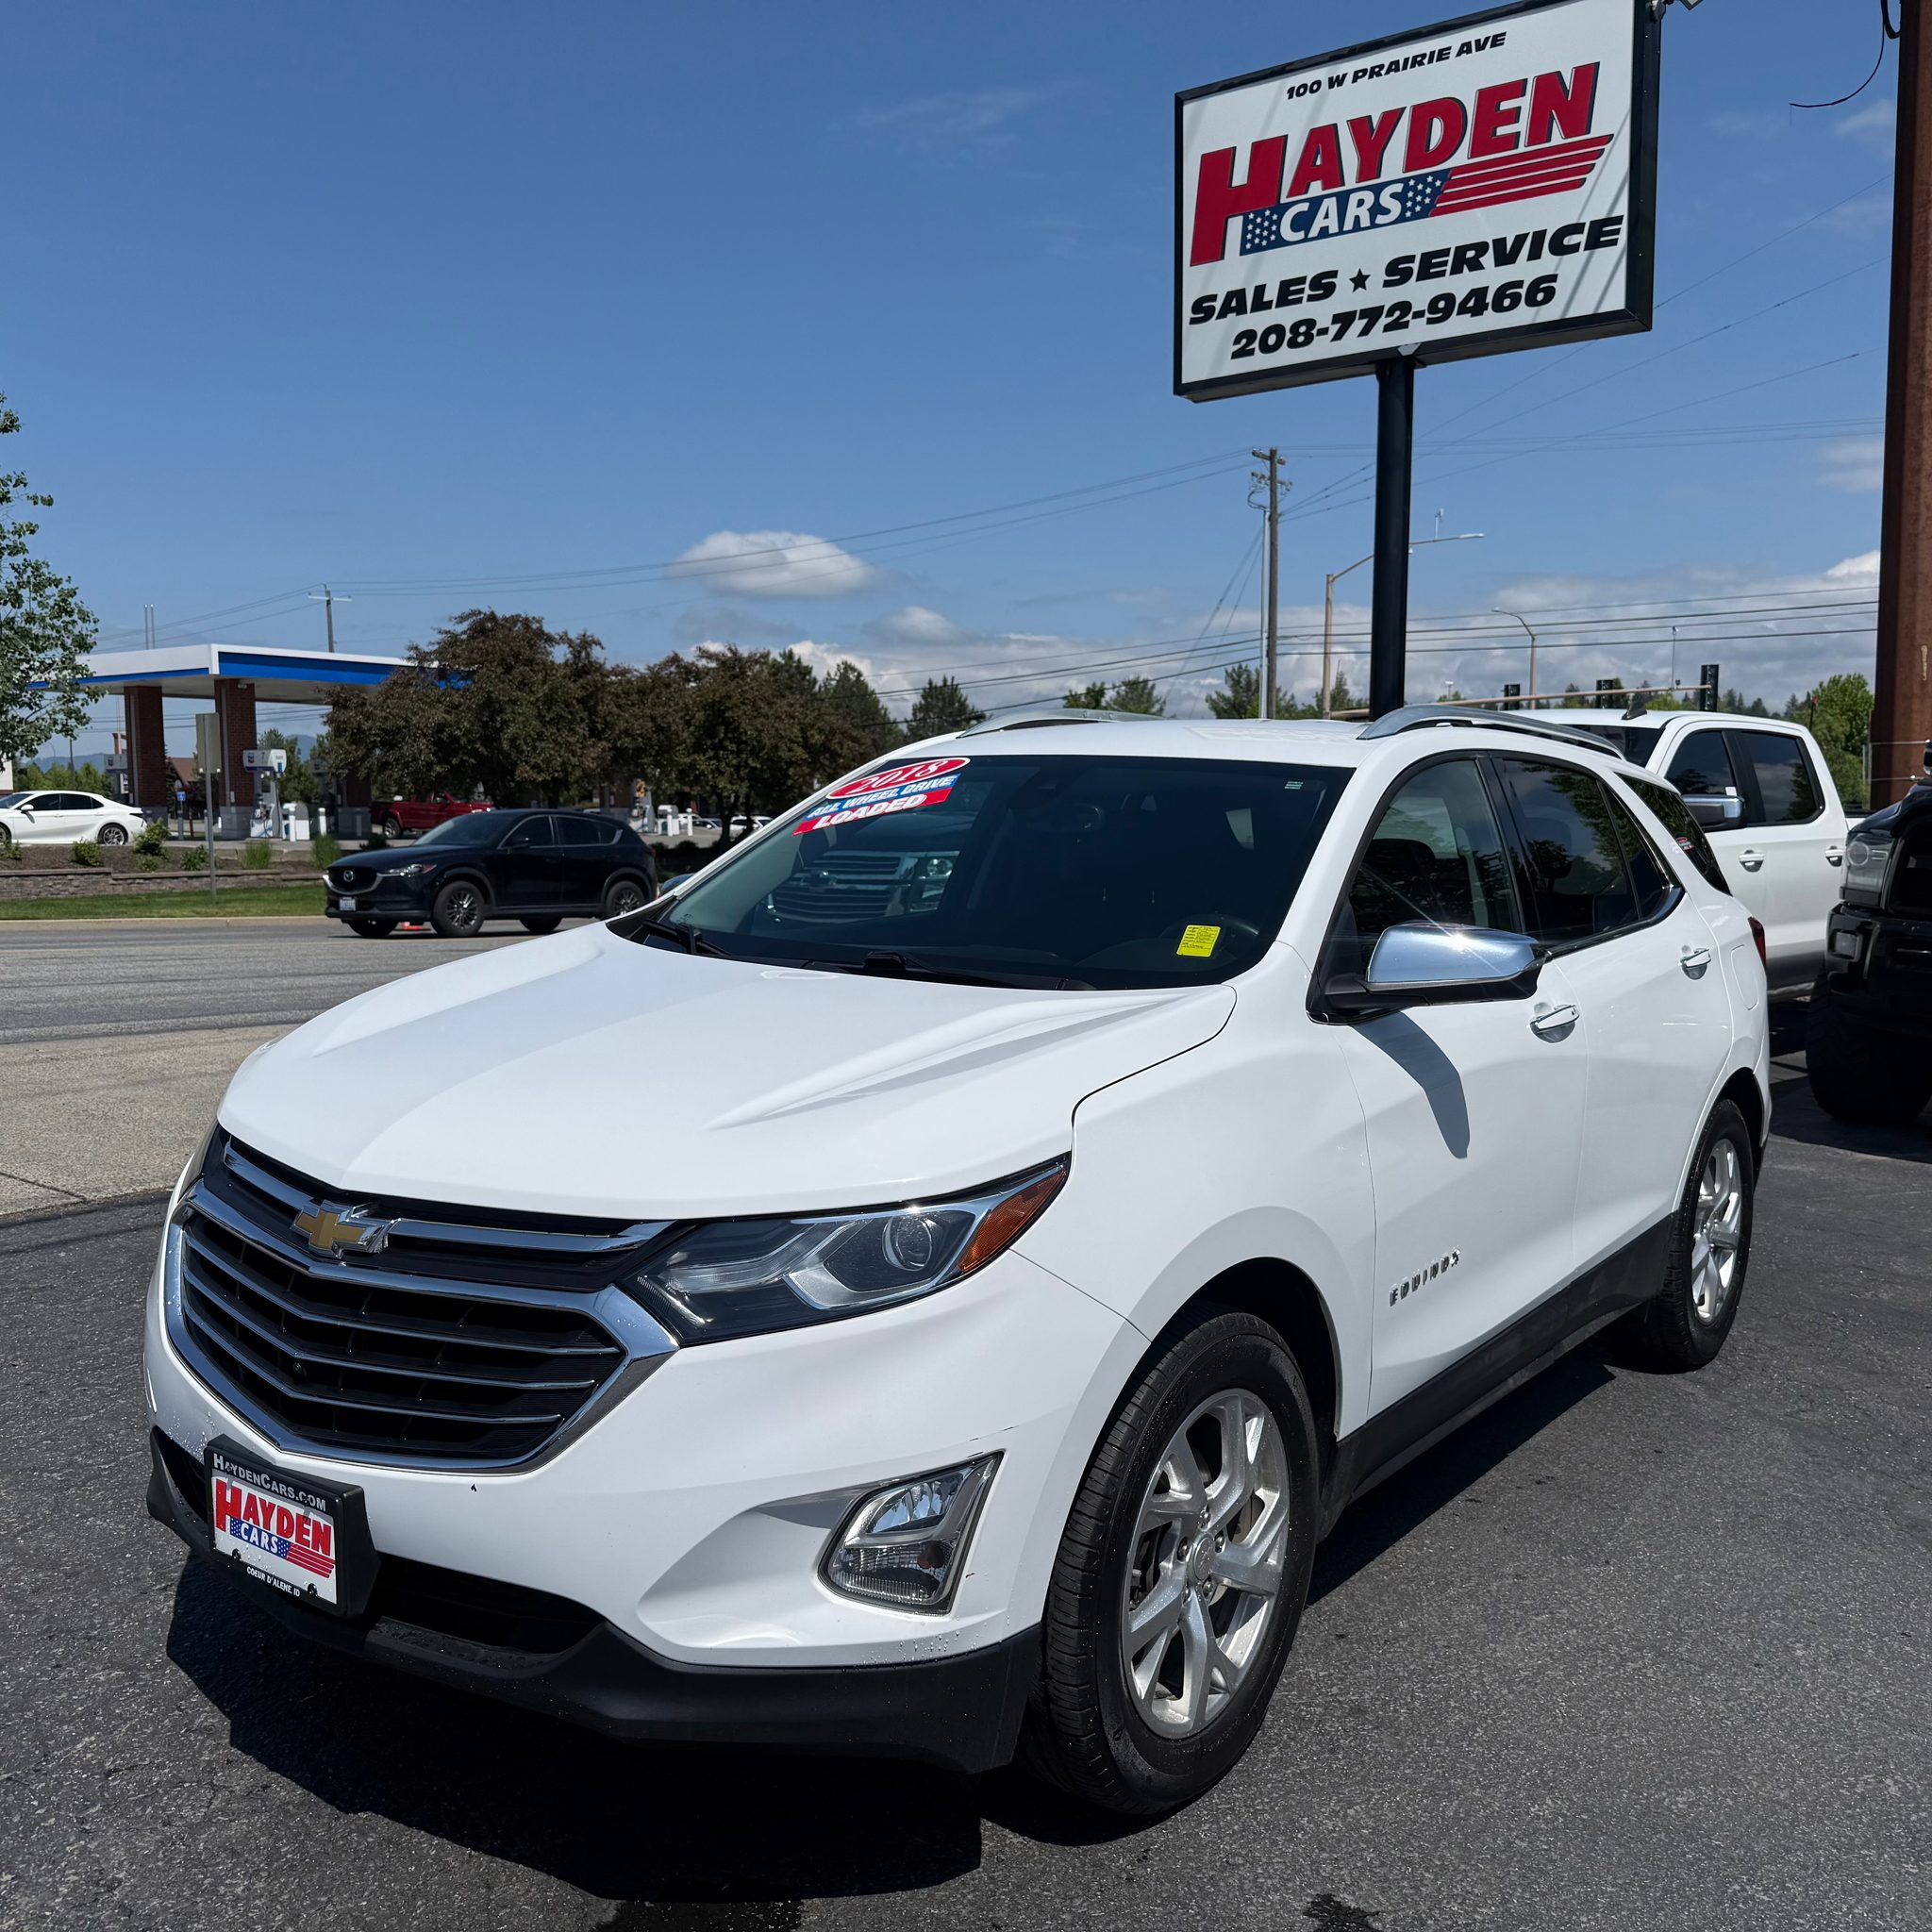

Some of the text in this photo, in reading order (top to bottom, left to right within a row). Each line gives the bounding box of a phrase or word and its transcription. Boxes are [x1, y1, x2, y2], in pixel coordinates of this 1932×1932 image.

[1287, 32, 1507, 100] 100 W PRAIRIE AVE
[1190, 61, 1601, 267] HAYDEN
[1279, 181, 1405, 242] CARS
[1189, 214, 1624, 325] SALES SERVICE
[1230, 274, 1558, 360] 208-772-9466
[808, 774, 959, 818] ALL WHEEL DRIVE
[846, 759, 949, 795] 2018
[812, 793, 928, 830] LOADED
[215, 1478, 332, 1557] HAYDEN
[240, 1522, 279, 1555] CARS
[246, 1566, 265, 1581] COEUR
[293, 1587, 300, 1596] ID
